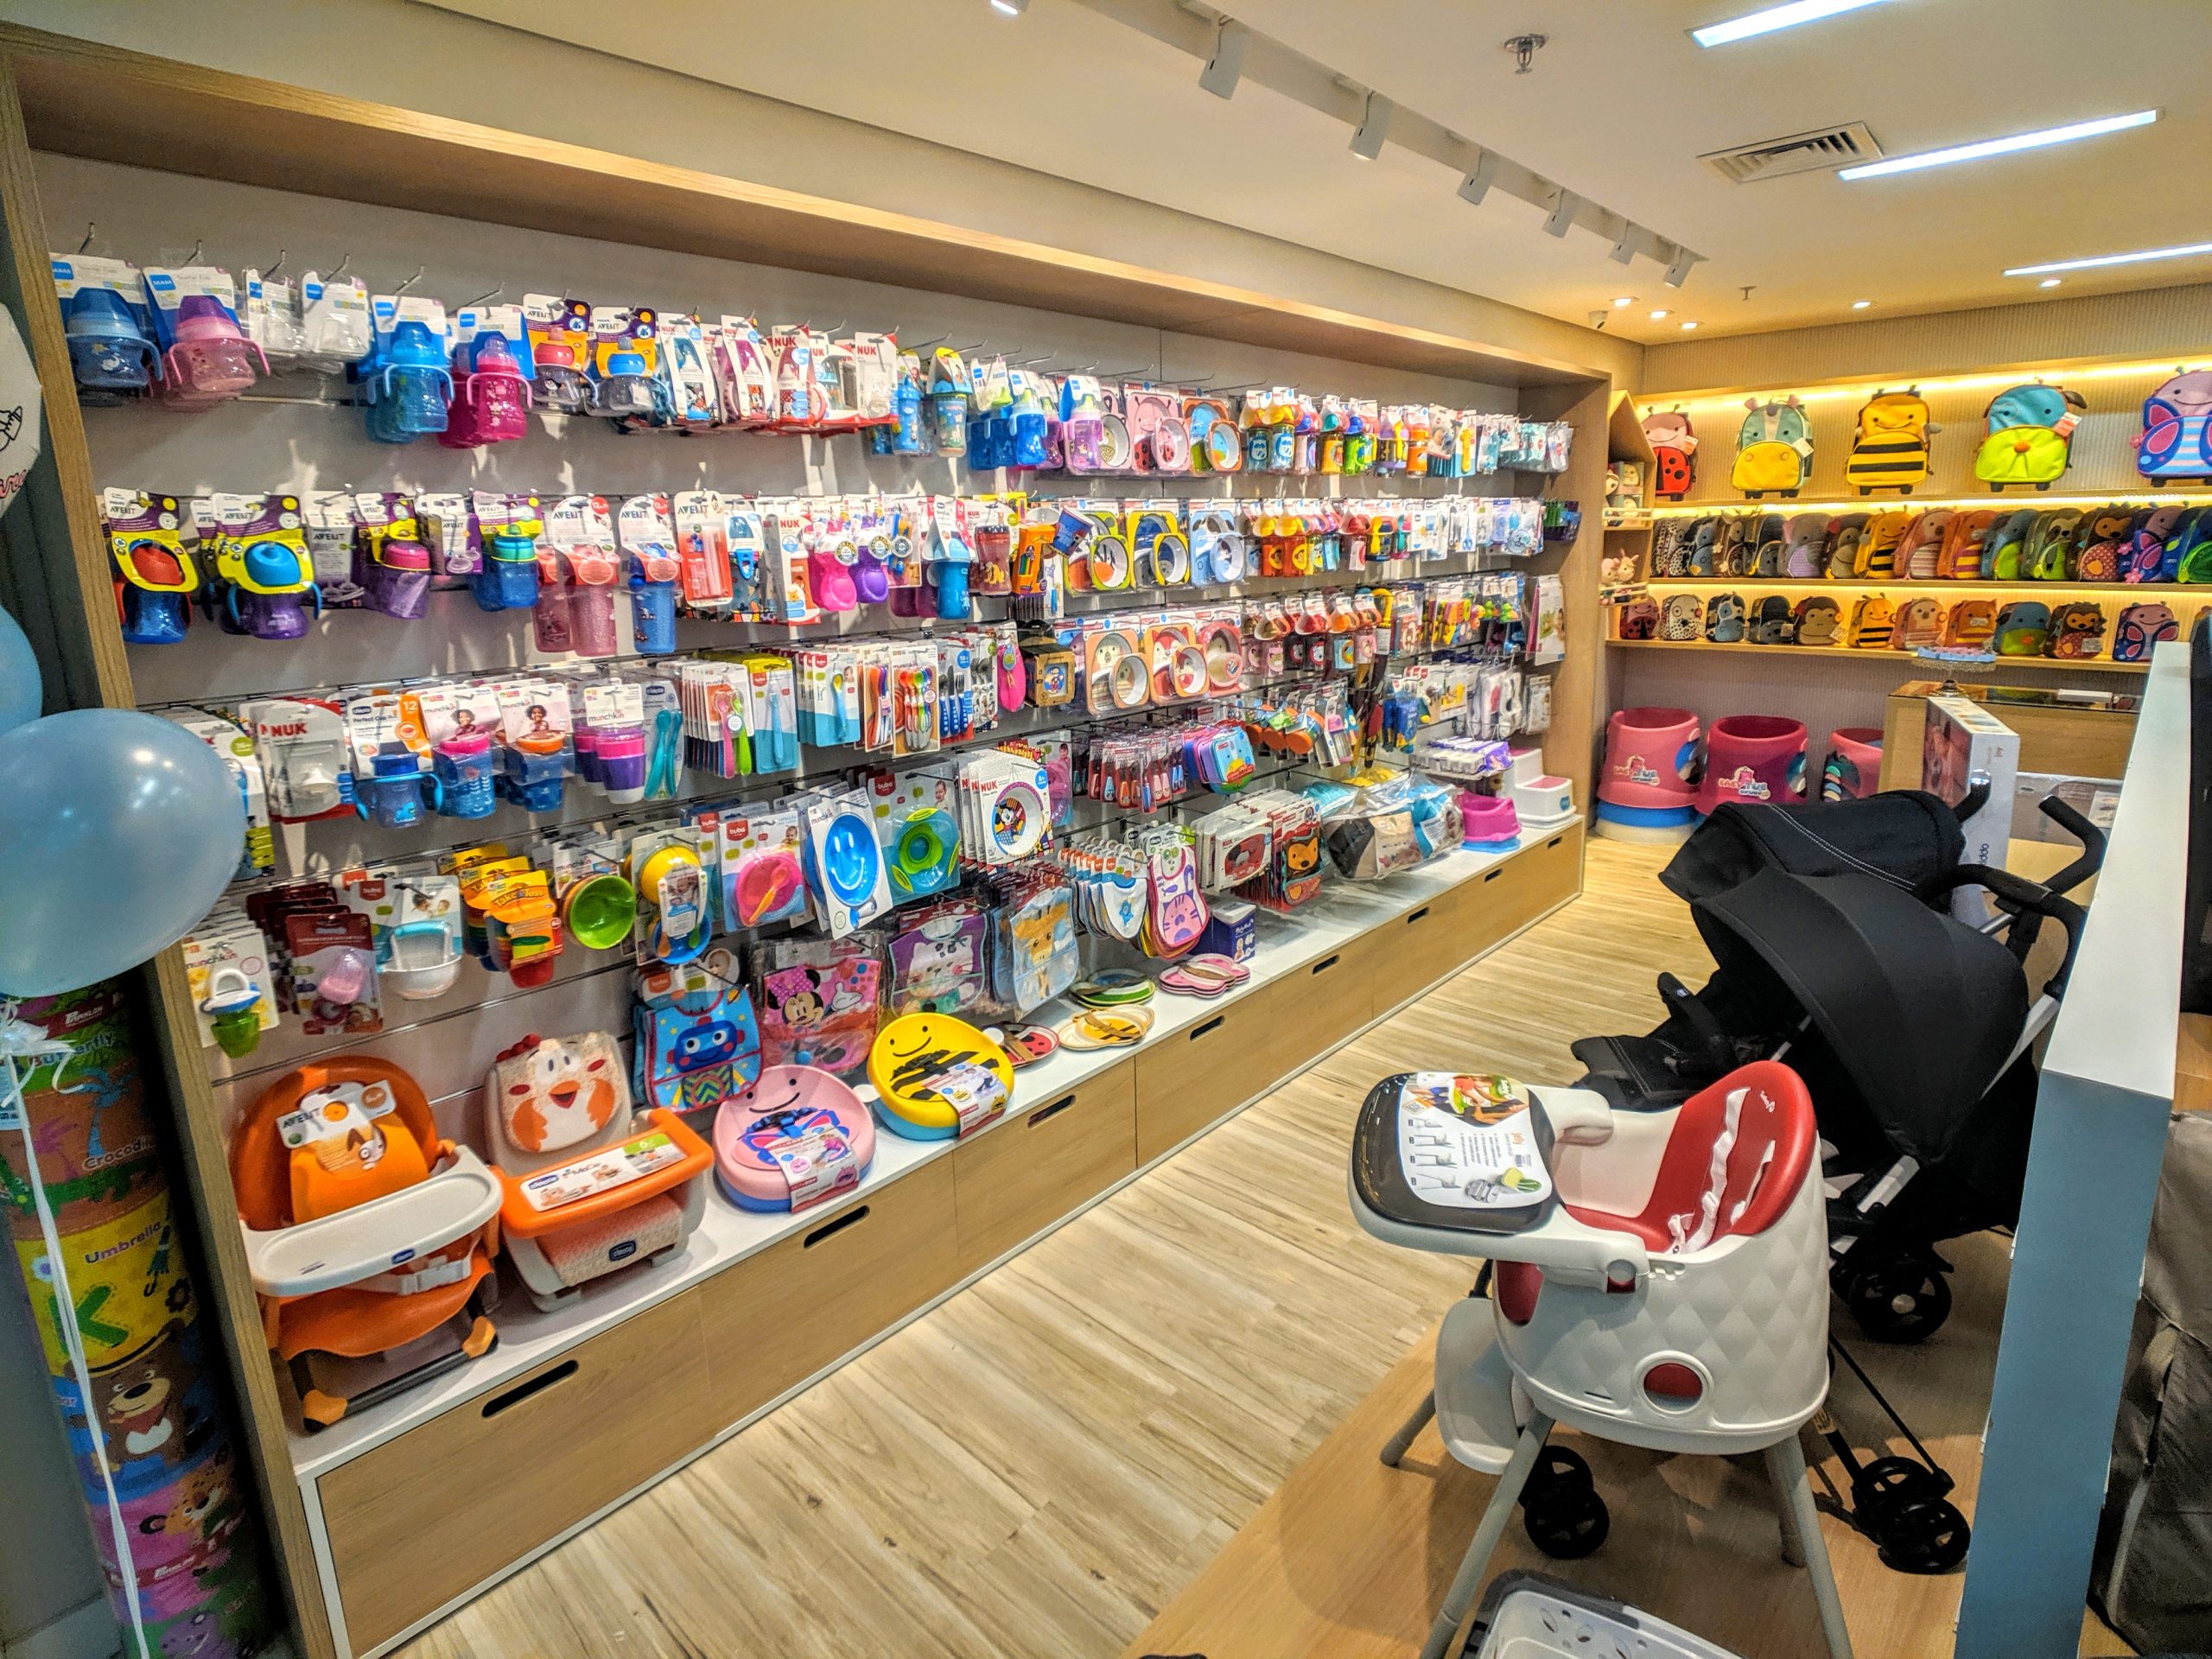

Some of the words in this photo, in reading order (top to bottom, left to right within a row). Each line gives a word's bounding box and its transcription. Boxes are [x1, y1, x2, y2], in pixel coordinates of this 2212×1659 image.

[774, 337, 796, 346] NUK
[857, 346, 877, 355] NUK
[677, 505, 709, 514] AVENT
[780, 519, 800, 528] NUK
[424, 703, 458, 714] munchkin
[502, 697, 531, 709] munchkin
[353, 715, 374, 724] Perfect
[588, 709, 624, 722] munchkin
[271, 722, 307, 737] NUK
[981, 780, 998, 794] NUK
[495, 890, 518, 907] Take
[524, 888, 545, 898] Toss
[28, 1033, 116, 1068] Buterfly
[283, 1107, 320, 1128] AVENT
[85, 1221, 162, 1265] Umbrella
[49, 1285, 129, 1357] K
